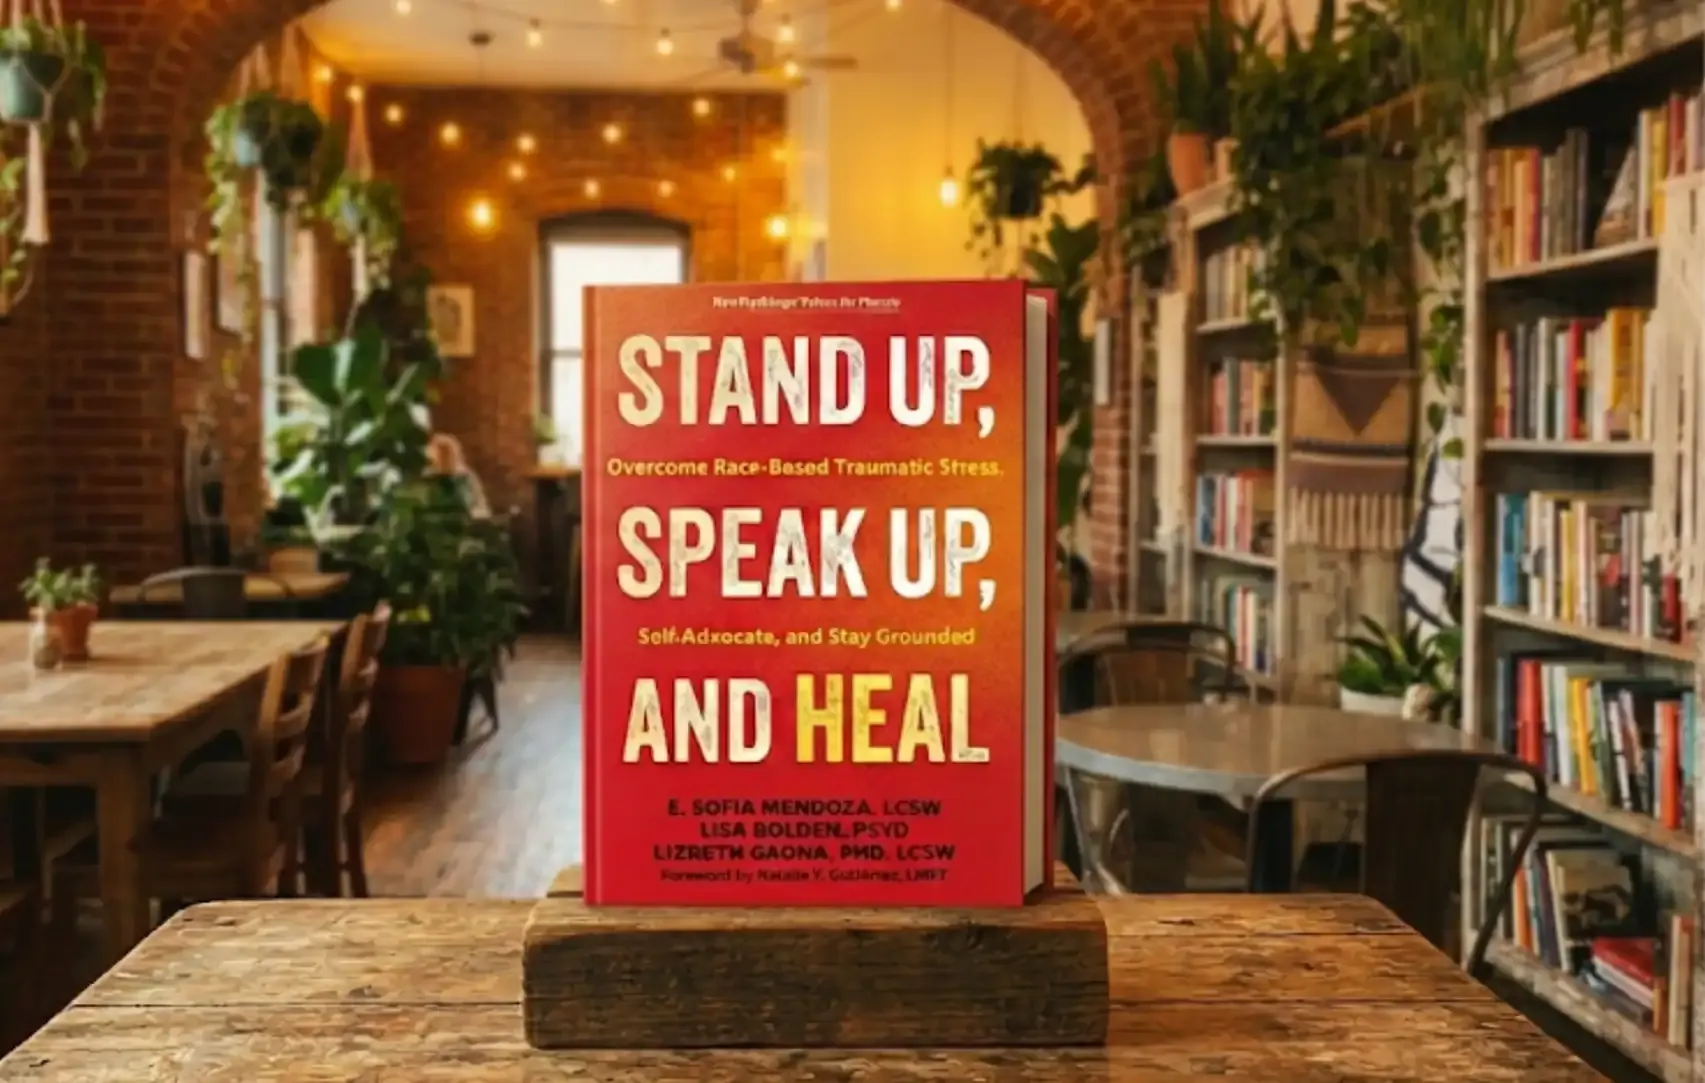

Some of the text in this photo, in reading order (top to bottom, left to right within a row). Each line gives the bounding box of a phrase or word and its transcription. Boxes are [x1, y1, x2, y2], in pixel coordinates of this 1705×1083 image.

[617, 334, 996, 438] STAND UP,
[607, 457, 709, 477] Overcome
[833, 457, 934, 477] Traumatic
[617, 505, 997, 611] SPEAK UP,
[785, 627, 823, 646] and
[828, 626, 872, 649] Stay
[875, 625, 976, 646] Grounded
[622, 673, 991, 764] AND HEAL
[668, 798, 687, 816] E.
[692, 798, 756, 816] SOFIA
[883, 799, 942, 816] LCSW
[700, 821, 747, 839] LISA
[853, 821, 910, 839] PSYD
[897, 844, 956, 861] LCSW
